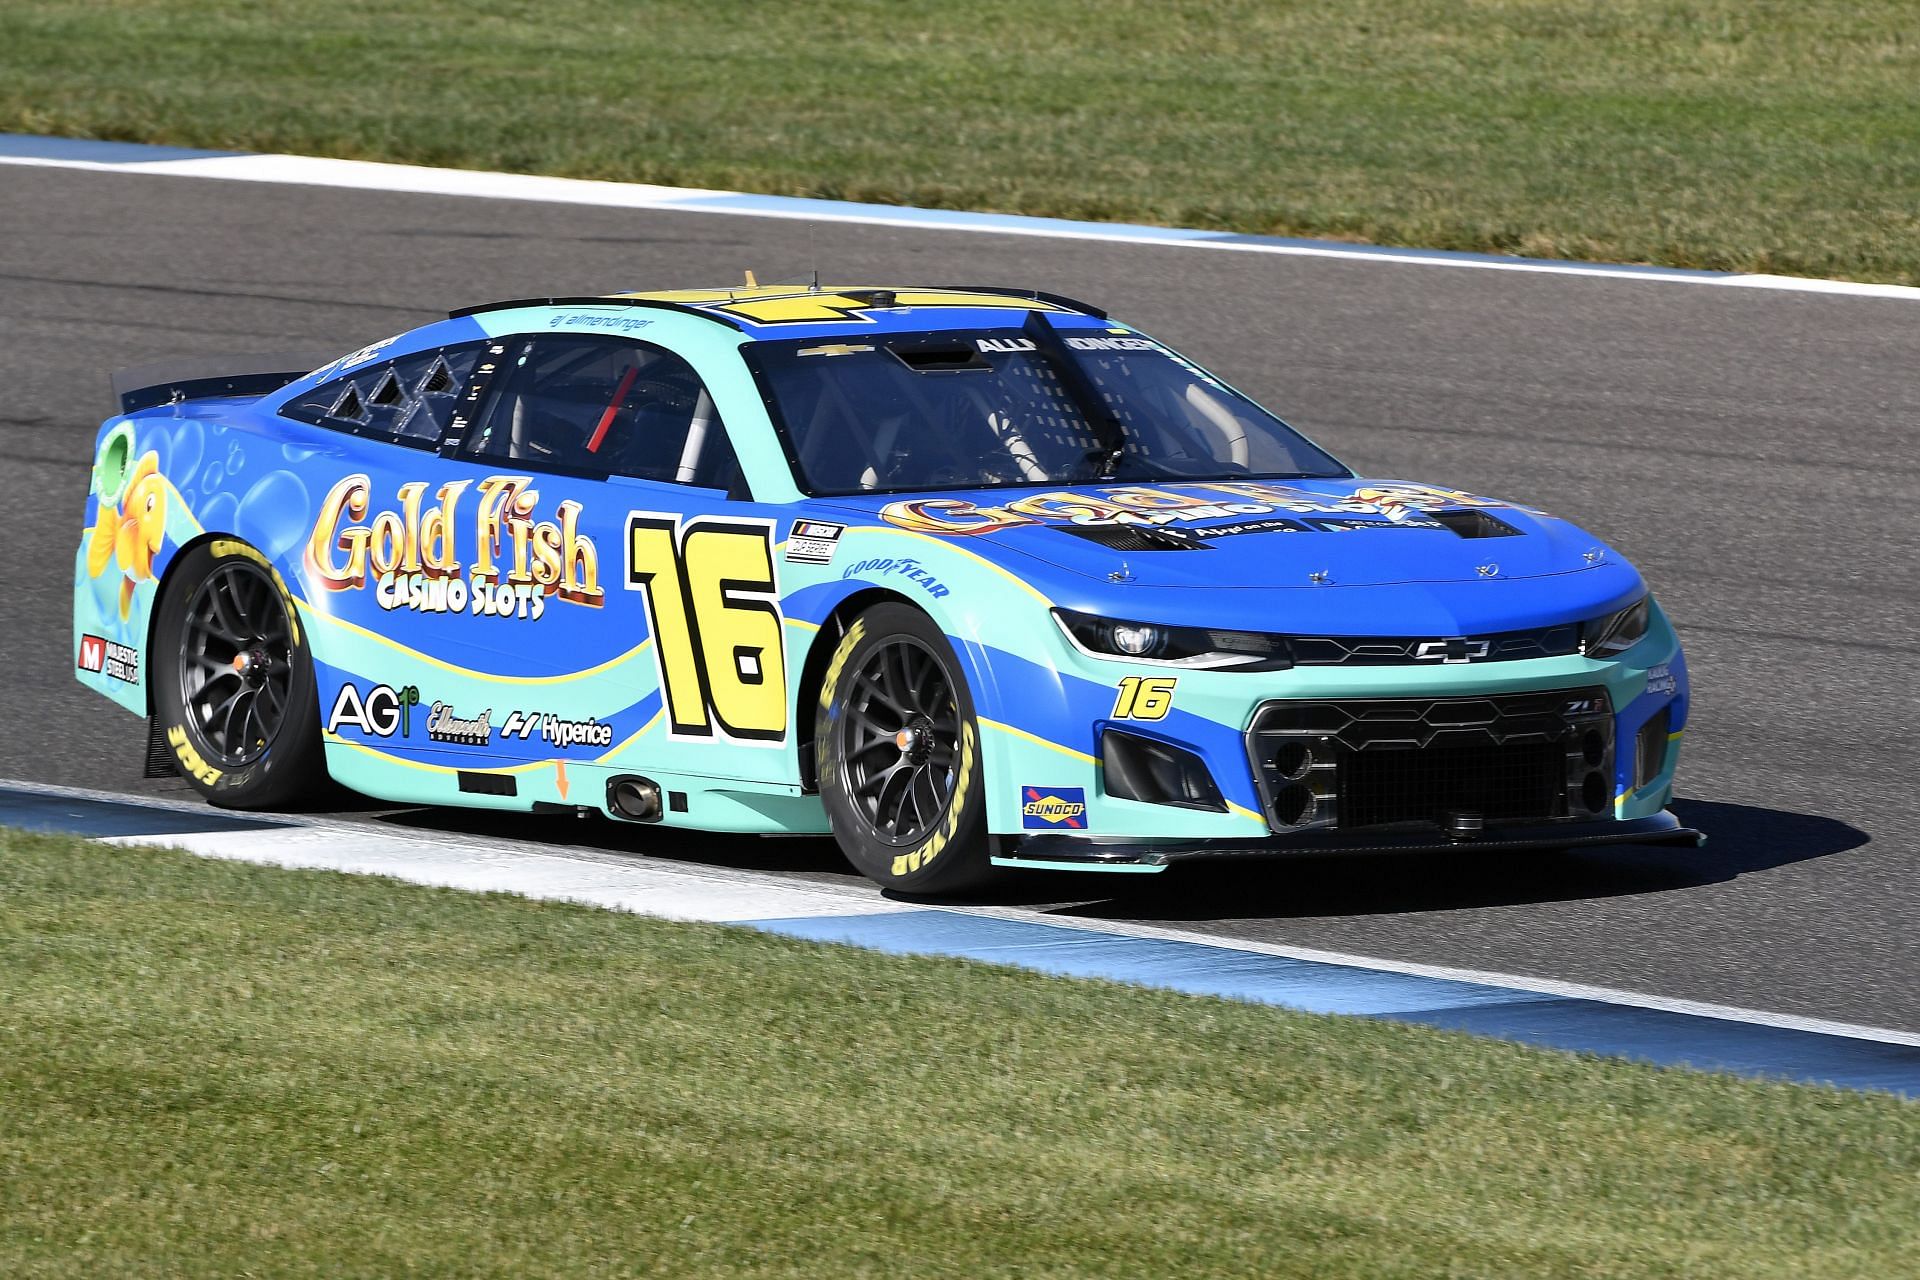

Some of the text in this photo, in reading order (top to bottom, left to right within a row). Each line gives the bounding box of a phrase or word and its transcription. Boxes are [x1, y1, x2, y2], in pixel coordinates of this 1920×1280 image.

[566, 314, 655, 331] allmendinger
[976, 337, 1153, 352] ALLDINGER
[305, 474, 604, 608] Gold Fish
[376, 571, 545, 622] CASINO SLOTS
[842, 558, 951, 600] GOODYEAR
[629, 517, 787, 742] 16
[1113, 676, 1177, 720] 16
[542, 714, 612, 746] Hyperice
[1026, 803, 1081, 815] SUNOCO
